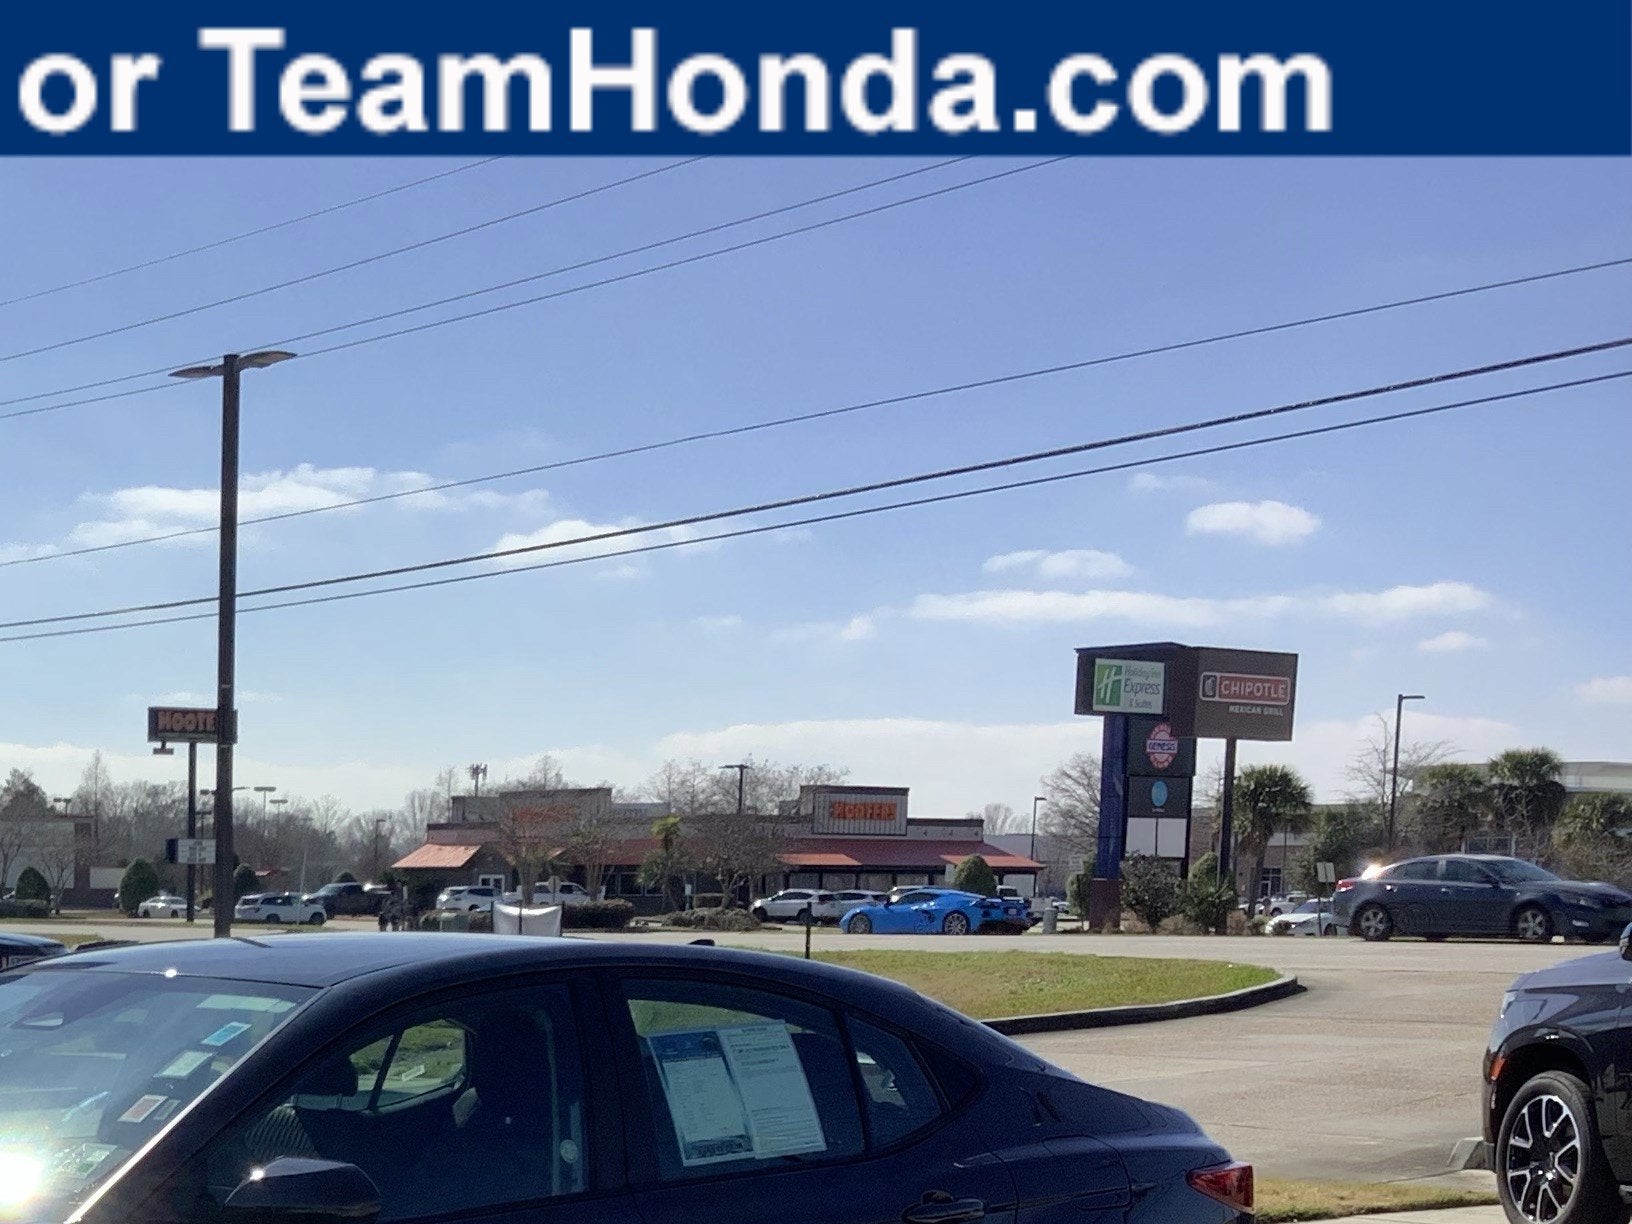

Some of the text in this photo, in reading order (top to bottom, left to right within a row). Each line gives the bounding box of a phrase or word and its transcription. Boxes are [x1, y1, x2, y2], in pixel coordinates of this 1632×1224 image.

[1123, 679, 1161, 697] Express
[1220, 681, 1287, 698] CHIPOTLE
[1228, 705, 1262, 714] MEXICAN
